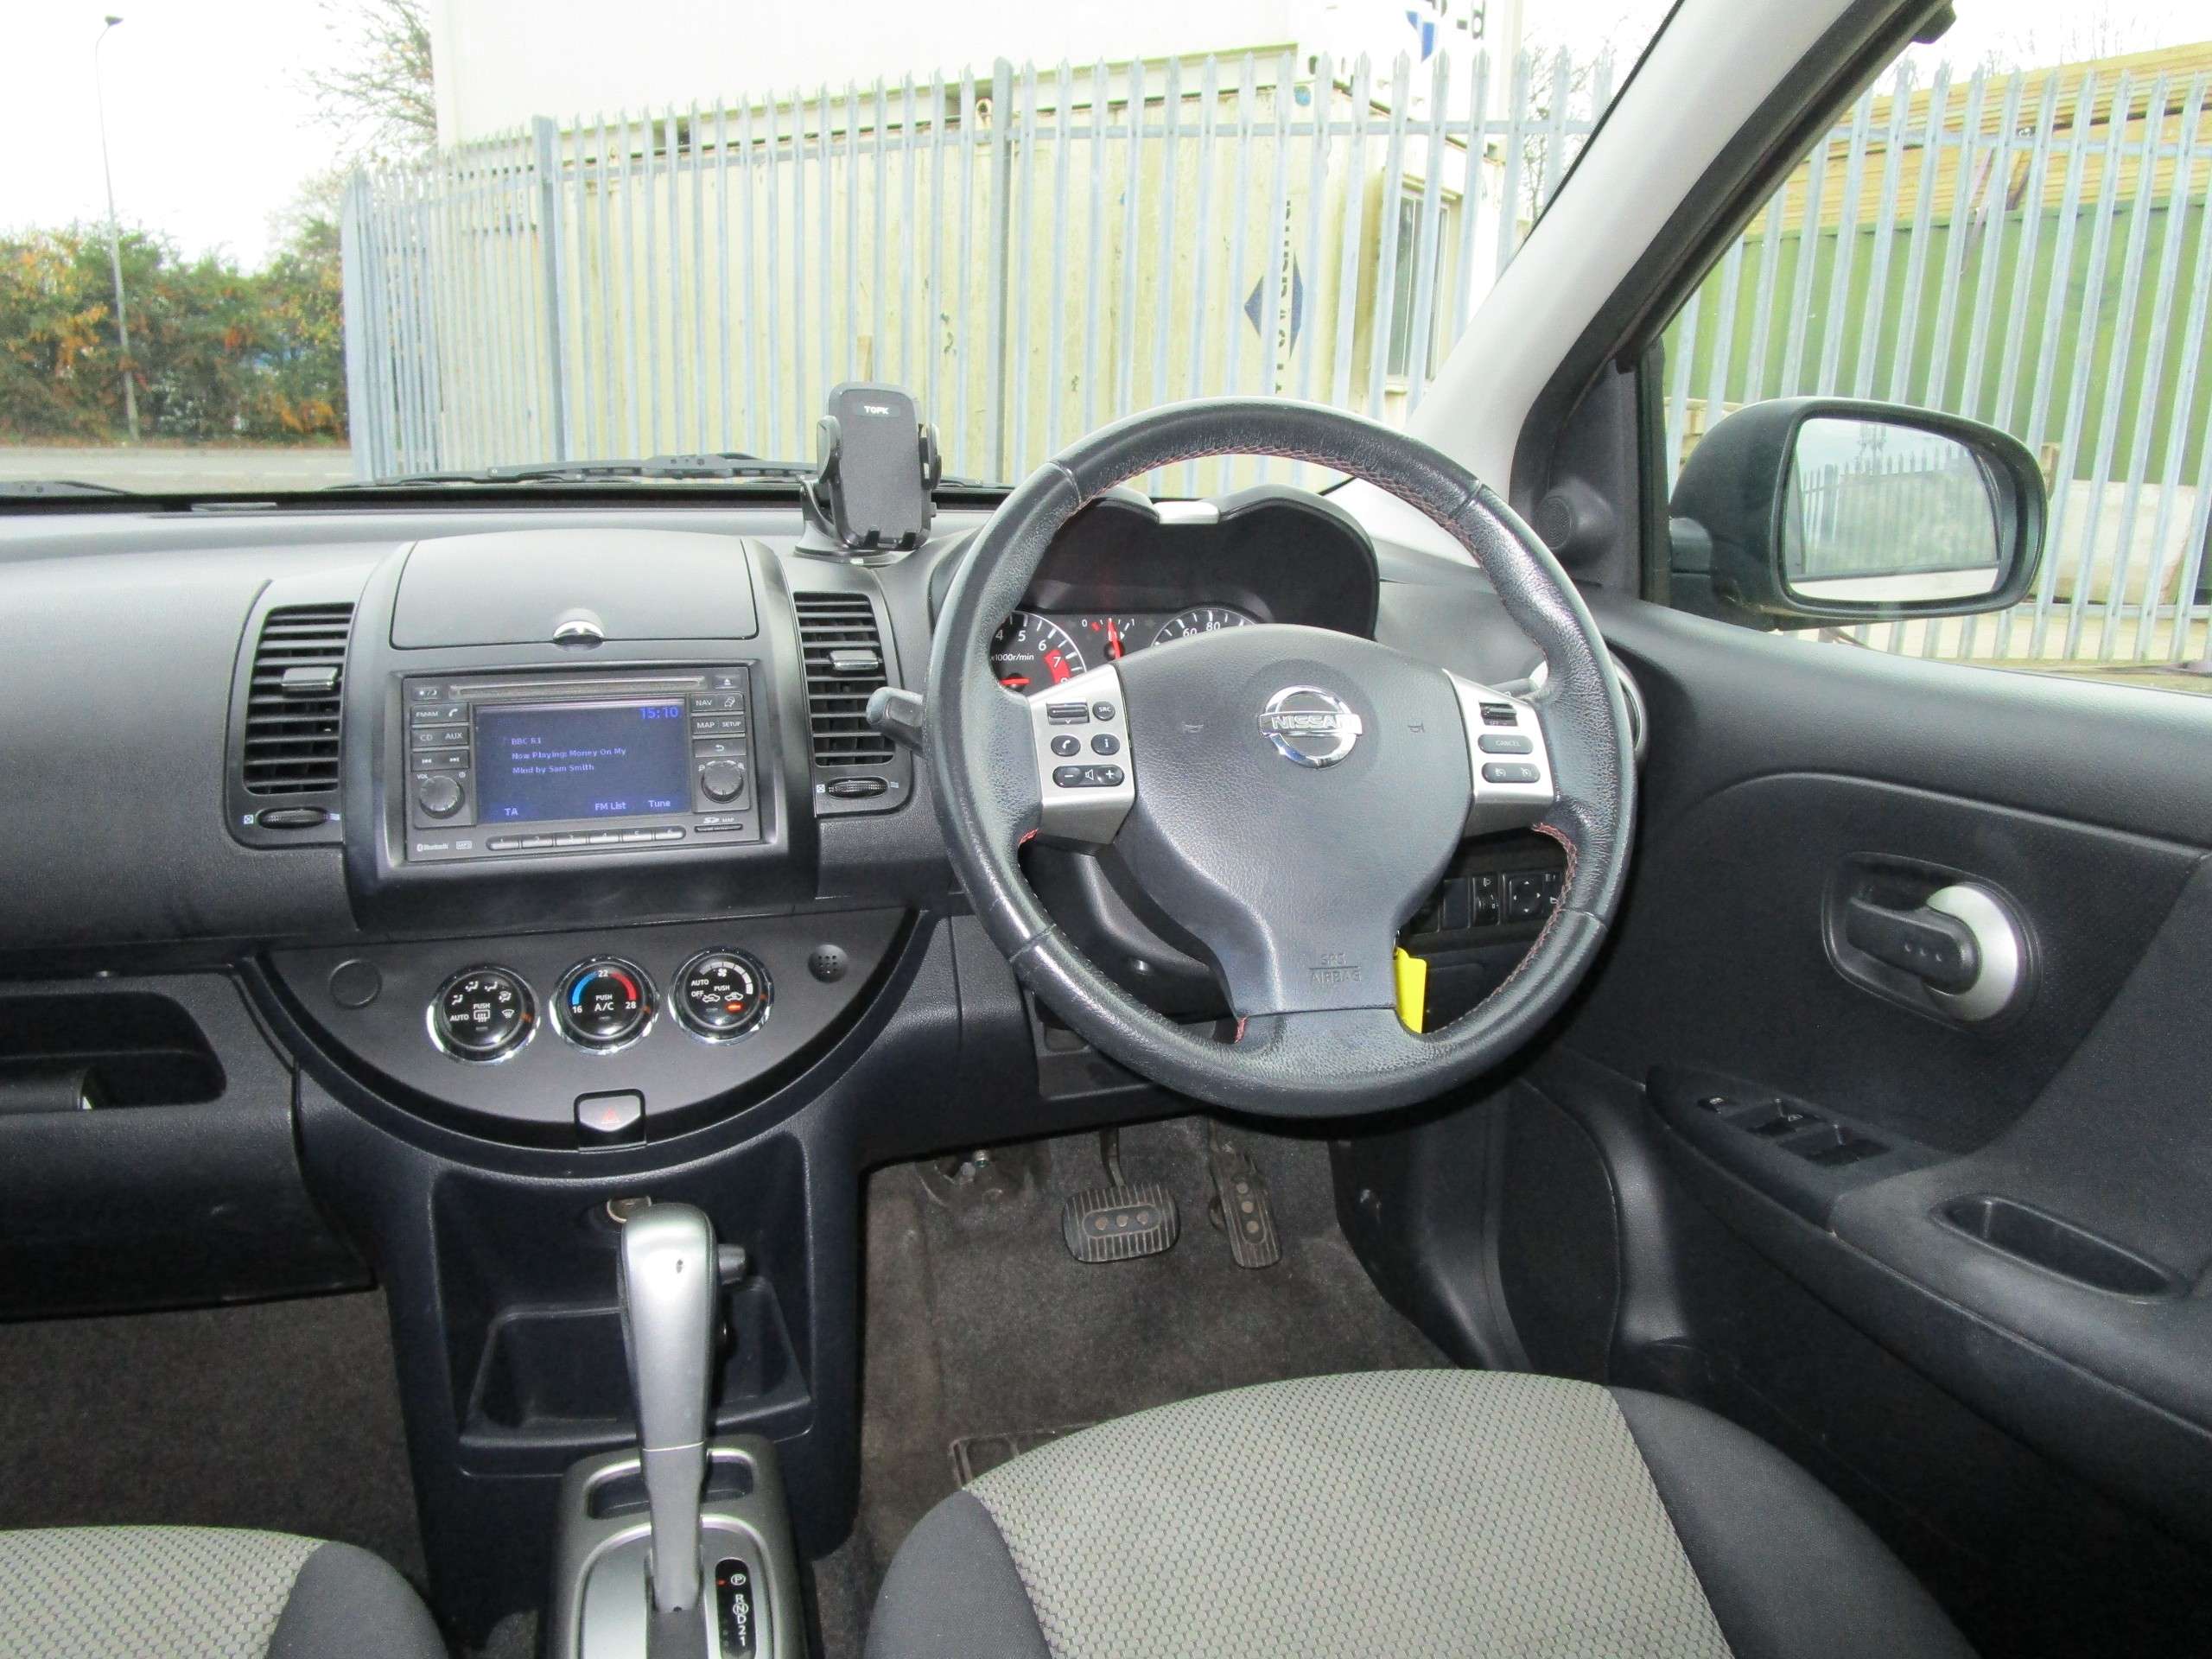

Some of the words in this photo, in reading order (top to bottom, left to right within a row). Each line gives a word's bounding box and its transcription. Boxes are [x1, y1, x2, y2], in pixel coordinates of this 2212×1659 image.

[1081, 619, 1088, 627] 0
[1206, 621, 1221, 631] 80
[1018, 630, 1027, 641] 5
[1183, 627, 1198, 638] 60
[1039, 639, 1047, 651] 6
[1053, 656, 1061, 668] 7
[640, 706, 679, 719] 15:10
[445, 732, 463, 741] AUX
[512, 751, 531, 760] Now
[569, 749, 598, 758] Money
[600, 747, 612, 756] On
[613, 747, 626, 755] My
[535, 765, 546, 774] by
[569, 763, 594, 772] Smith
[594, 802, 609, 810] FM
[610, 801, 627, 810] List
[504, 808, 518, 817] TA
[594, 1002, 614, 1012] A/C
[735, 1594, 744, 1604] R
[737, 1615, 747, 1624] D
[738, 1625, 747, 1636] 2
[740, 1637, 746, 1647] 1
